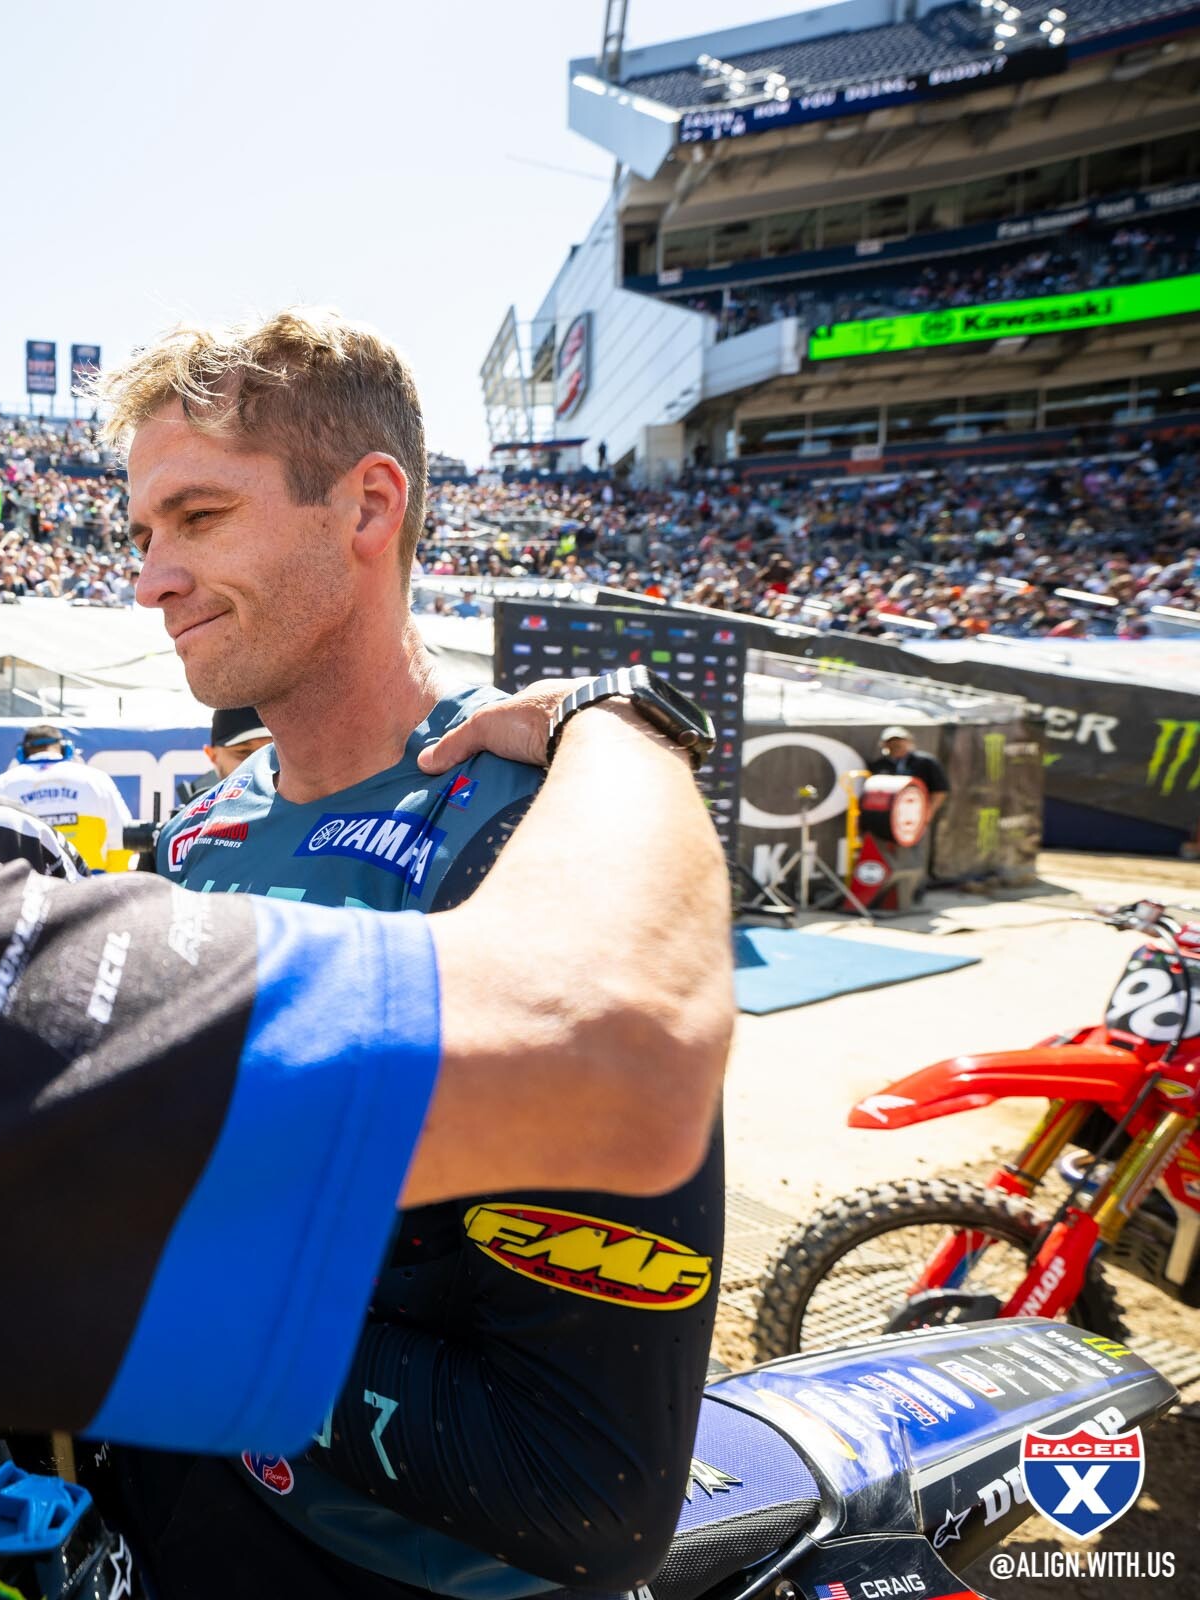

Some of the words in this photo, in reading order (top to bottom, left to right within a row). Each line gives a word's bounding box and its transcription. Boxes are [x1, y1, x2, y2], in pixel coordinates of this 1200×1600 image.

[962, 298, 1113, 333] Kawasaki
[61, 786, 78, 800] TEA
[214, 838, 243, 849] SPORTS
[466, 1207, 712, 1296] FMF
[1013, 1255, 1067, 1318] NLOP
[264, 1467, 290, 1485] Racing
[860, 1573, 926, 1600] CRAIG
